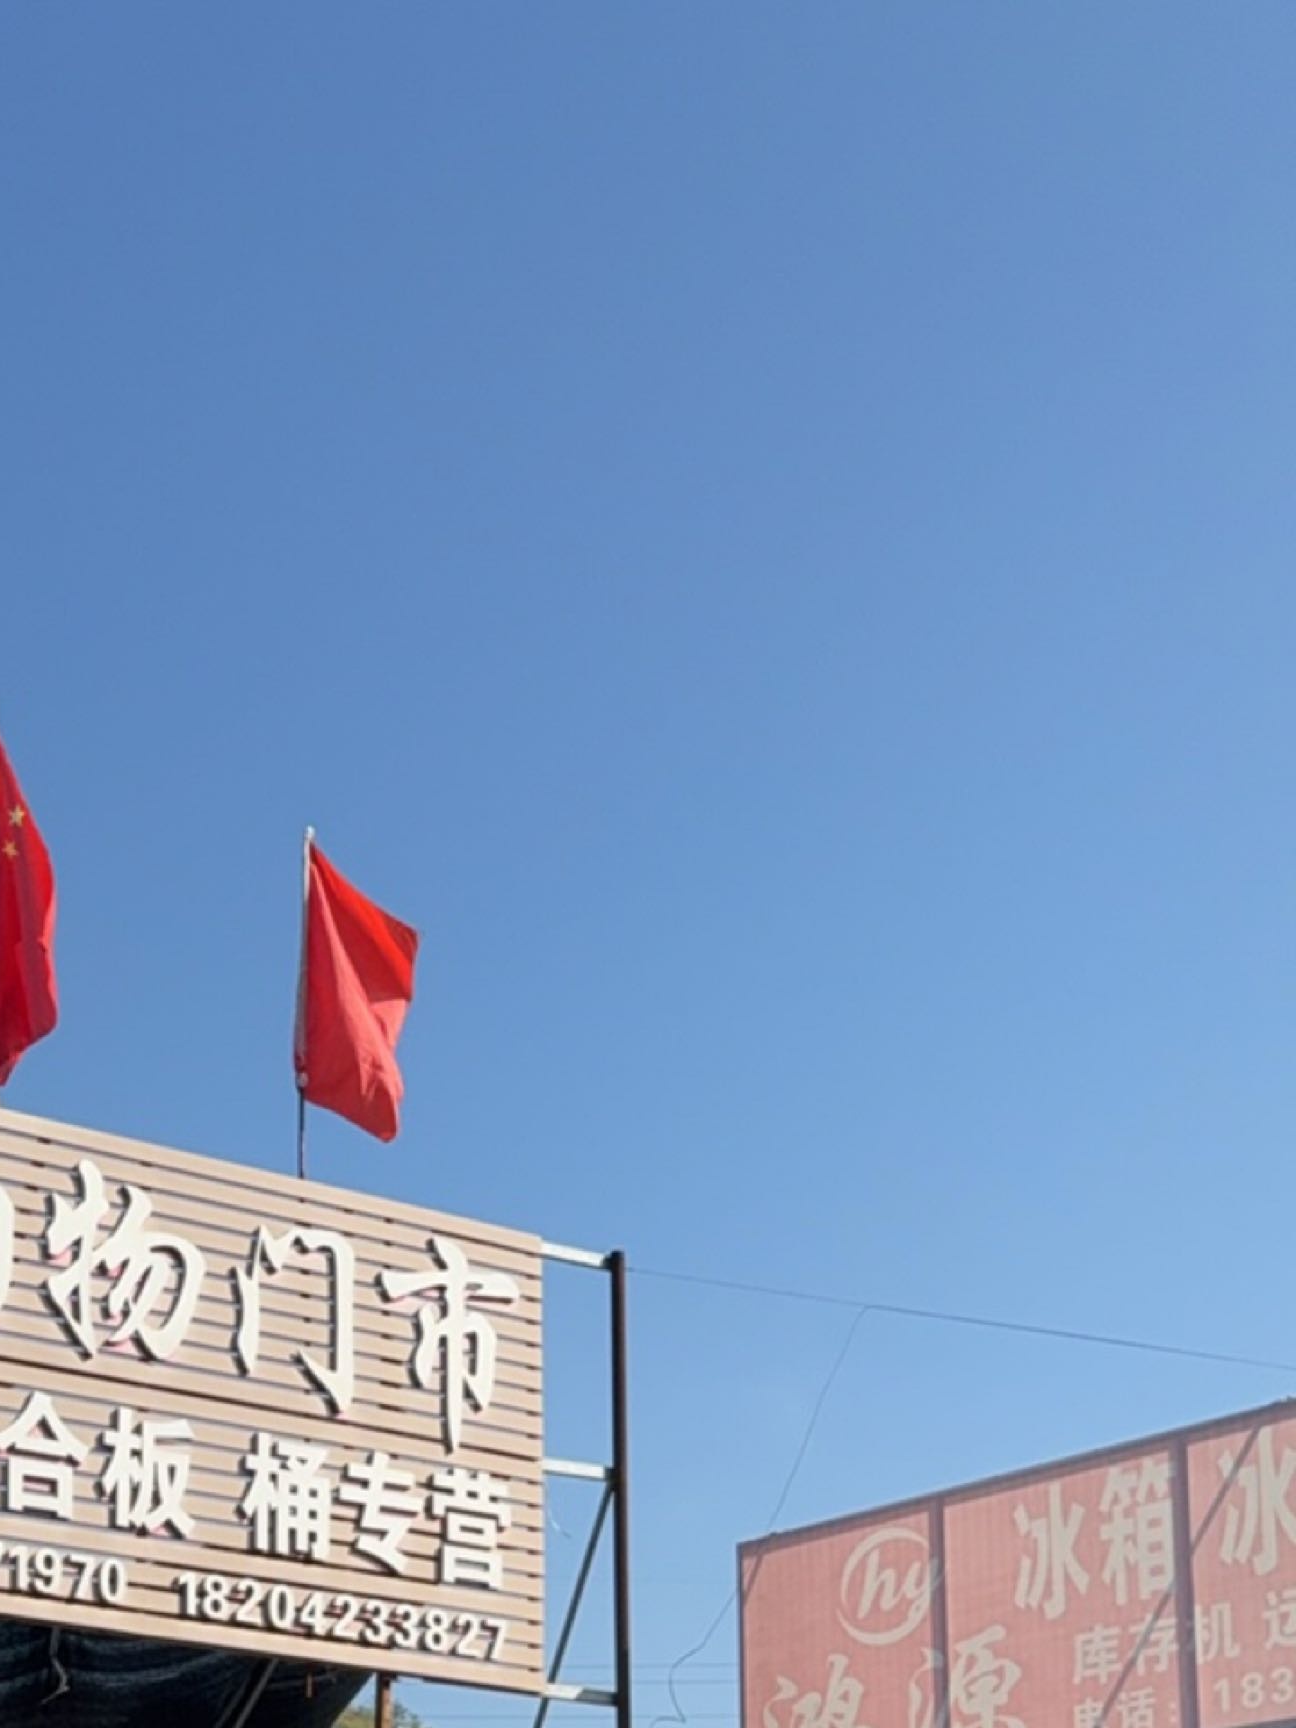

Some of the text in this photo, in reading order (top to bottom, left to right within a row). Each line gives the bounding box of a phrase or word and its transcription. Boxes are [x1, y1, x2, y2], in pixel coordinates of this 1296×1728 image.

[244, 1432, 512, 1591] 桶专营
[1013, 1458, 1178, 1620] 冰箱
[178, 1572, 508, 1660] 18204233827
[1073, 1603, 1241, 1687] 库存机
